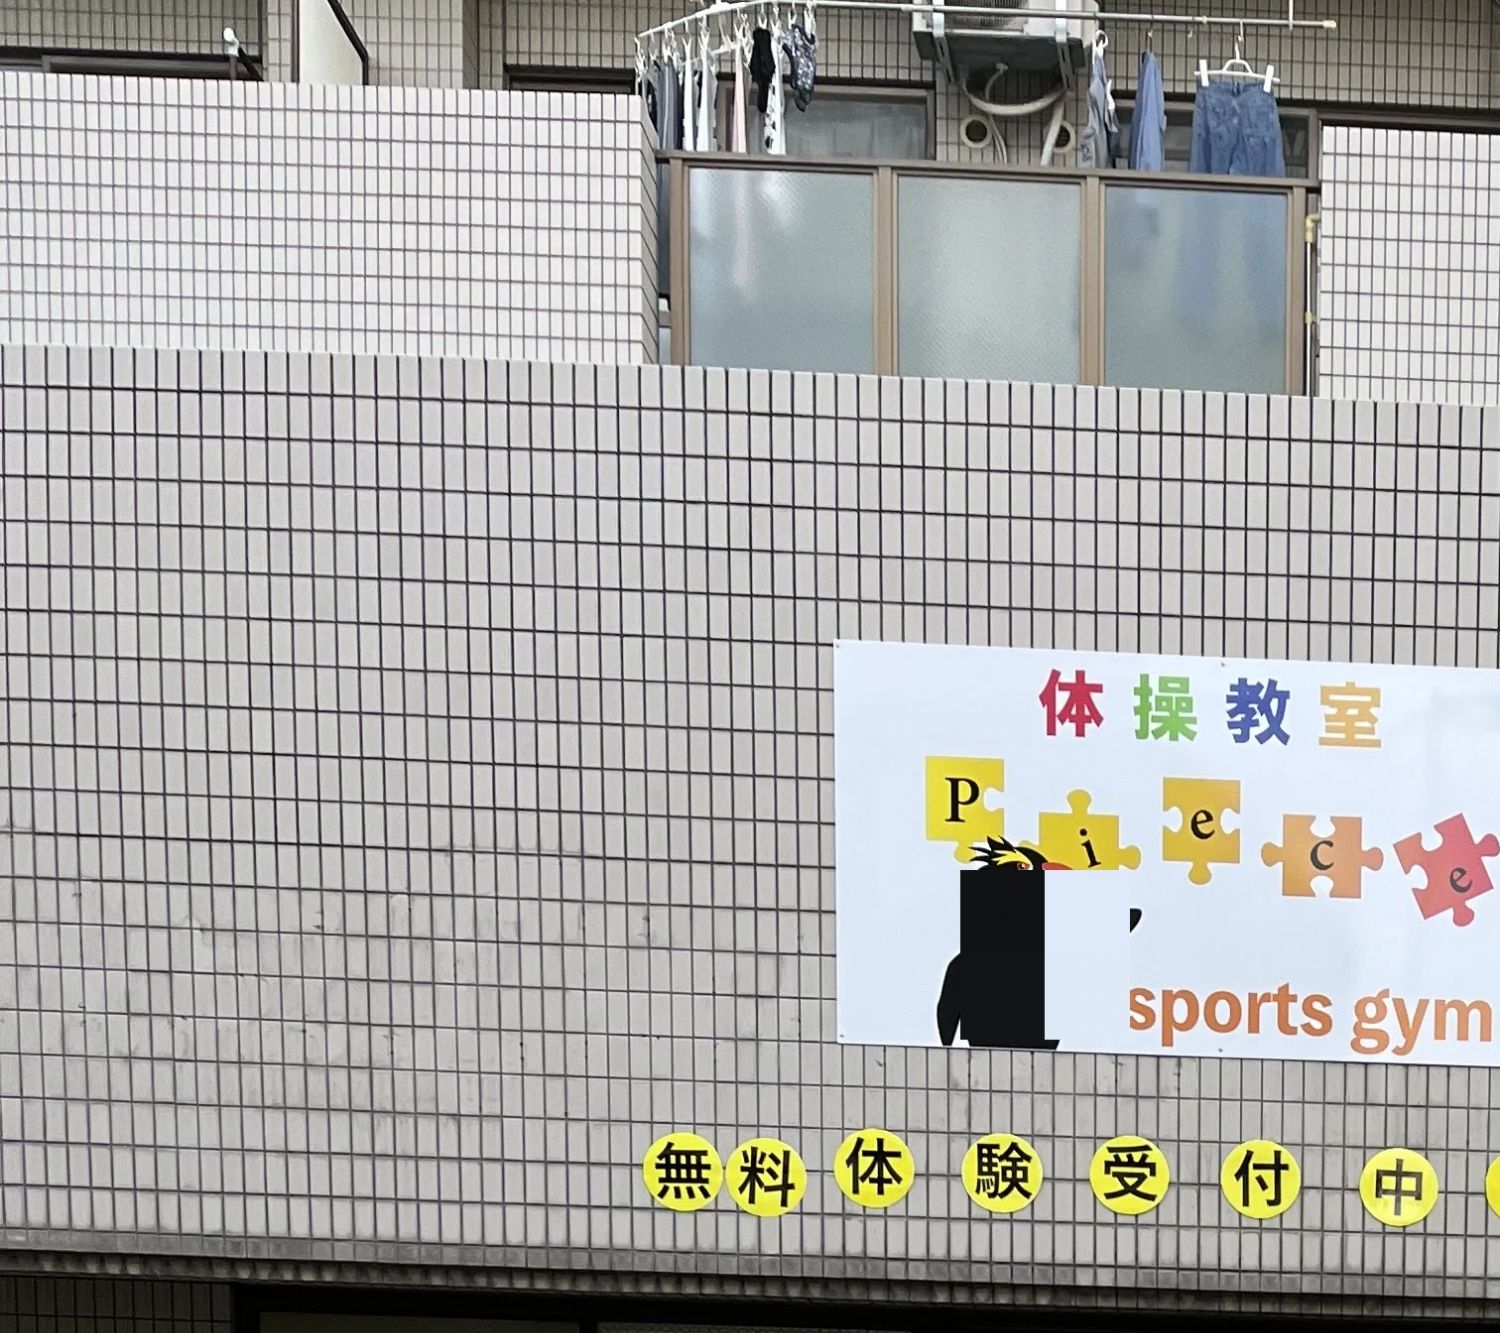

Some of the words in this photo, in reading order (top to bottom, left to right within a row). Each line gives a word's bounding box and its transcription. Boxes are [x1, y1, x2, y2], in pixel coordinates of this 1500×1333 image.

[1038, 668, 1382, 748] 体操教室
[944, 776, 1473, 893] Piece
[1130, 982, 1333, 1047] sports
[1350, 986, 1493, 1055] gym
